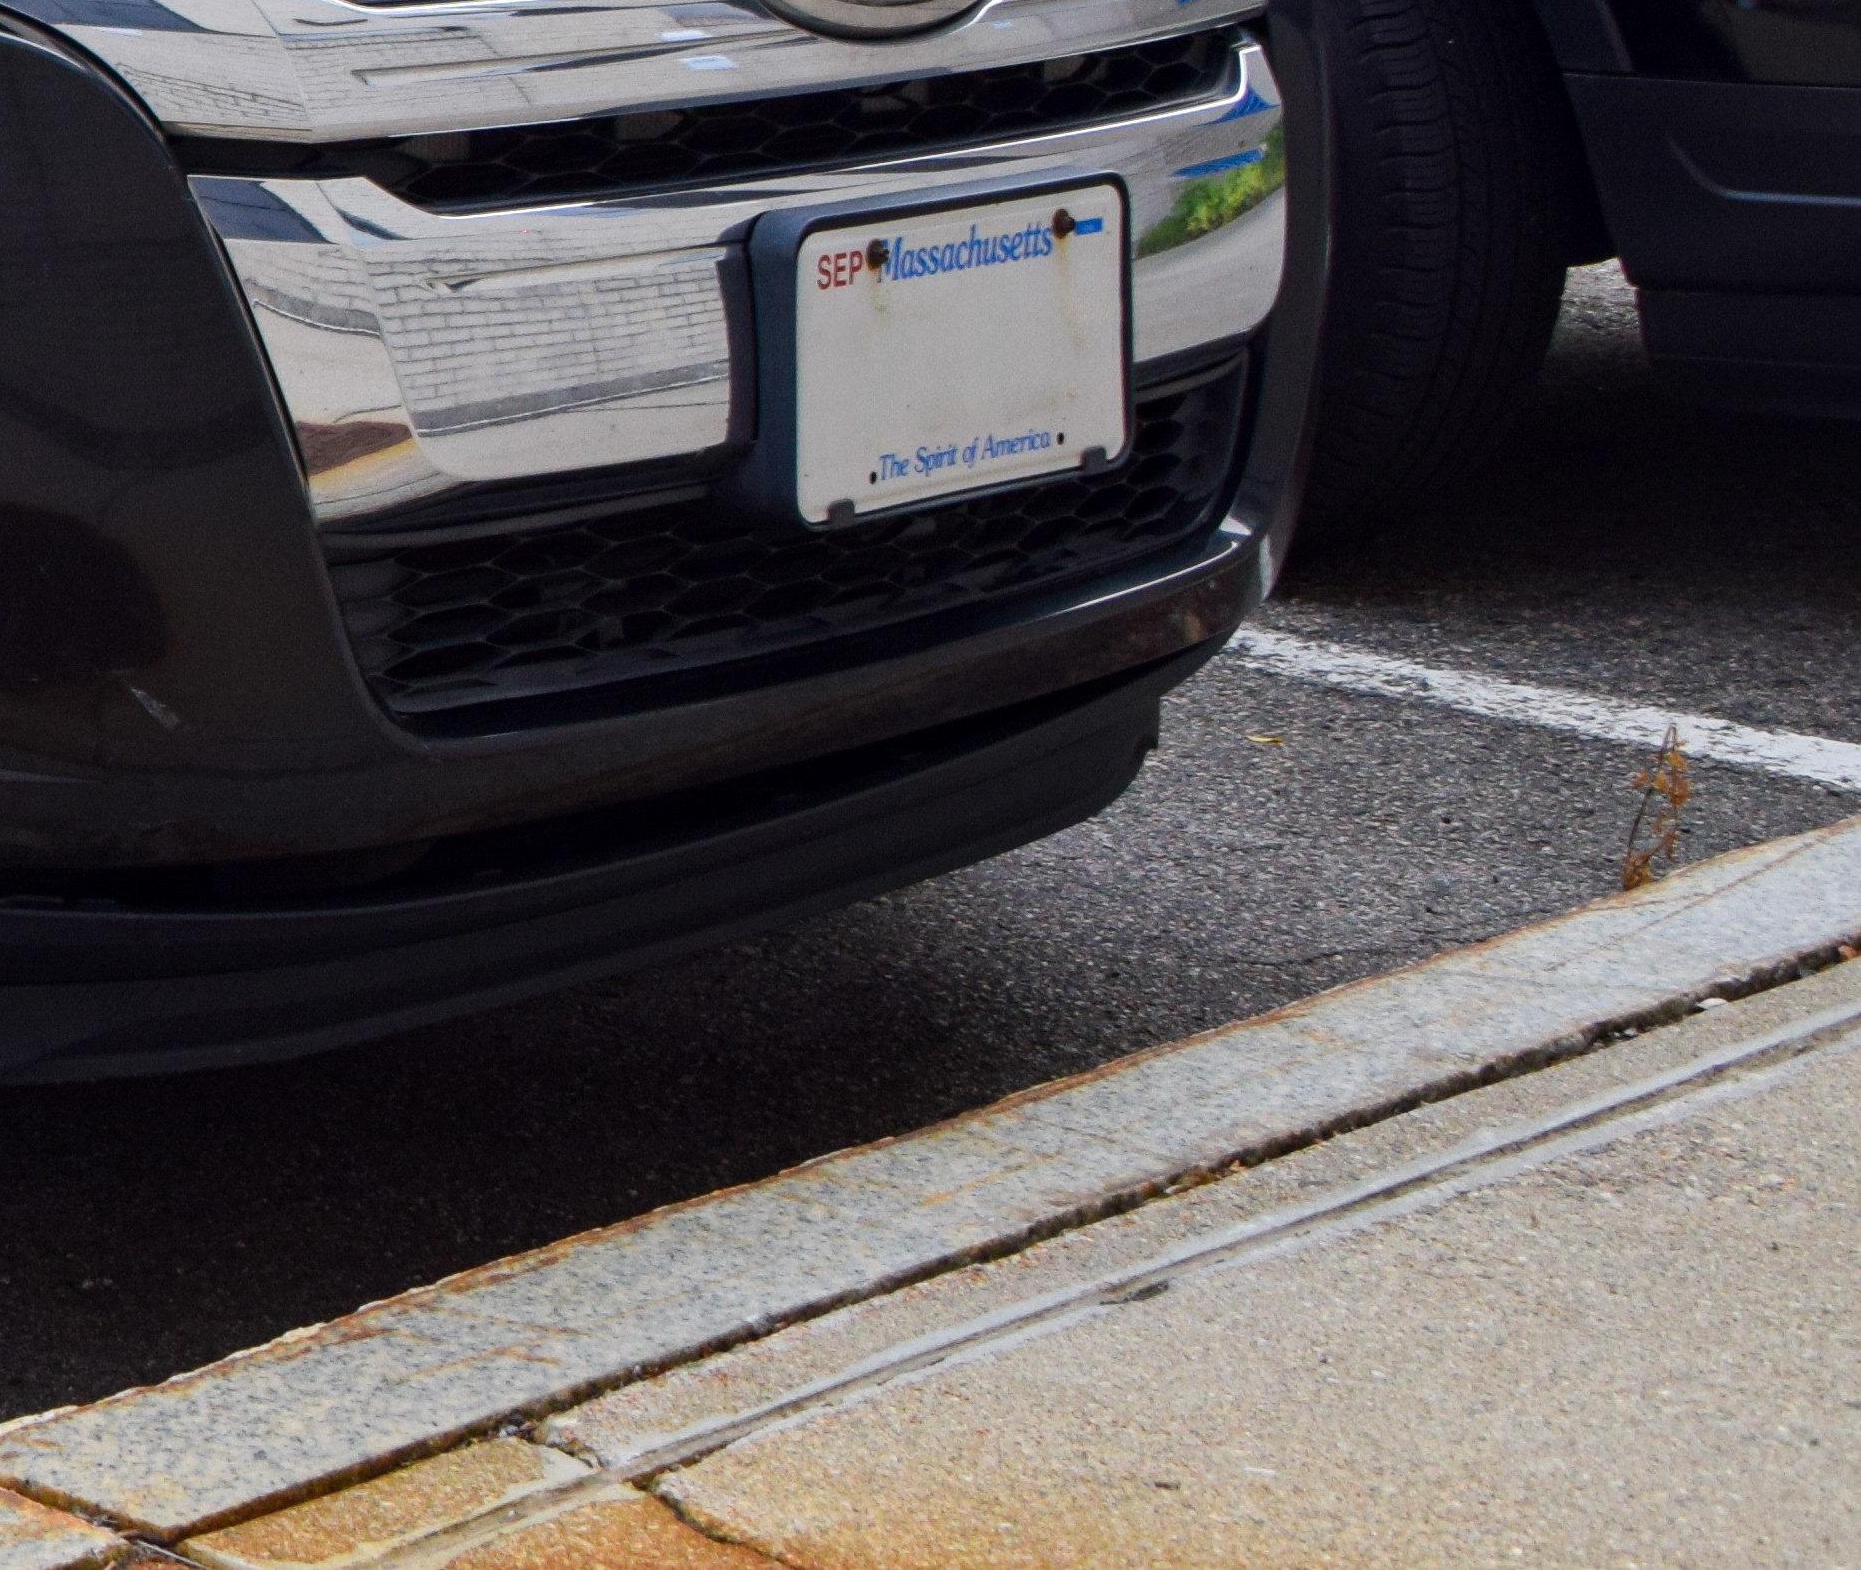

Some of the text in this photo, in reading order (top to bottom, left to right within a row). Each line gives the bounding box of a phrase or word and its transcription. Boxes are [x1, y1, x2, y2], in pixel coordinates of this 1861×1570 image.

[816, 223, 1053, 290] SEP Massachusetts
[879, 429, 1051, 482] The Spirit of America
